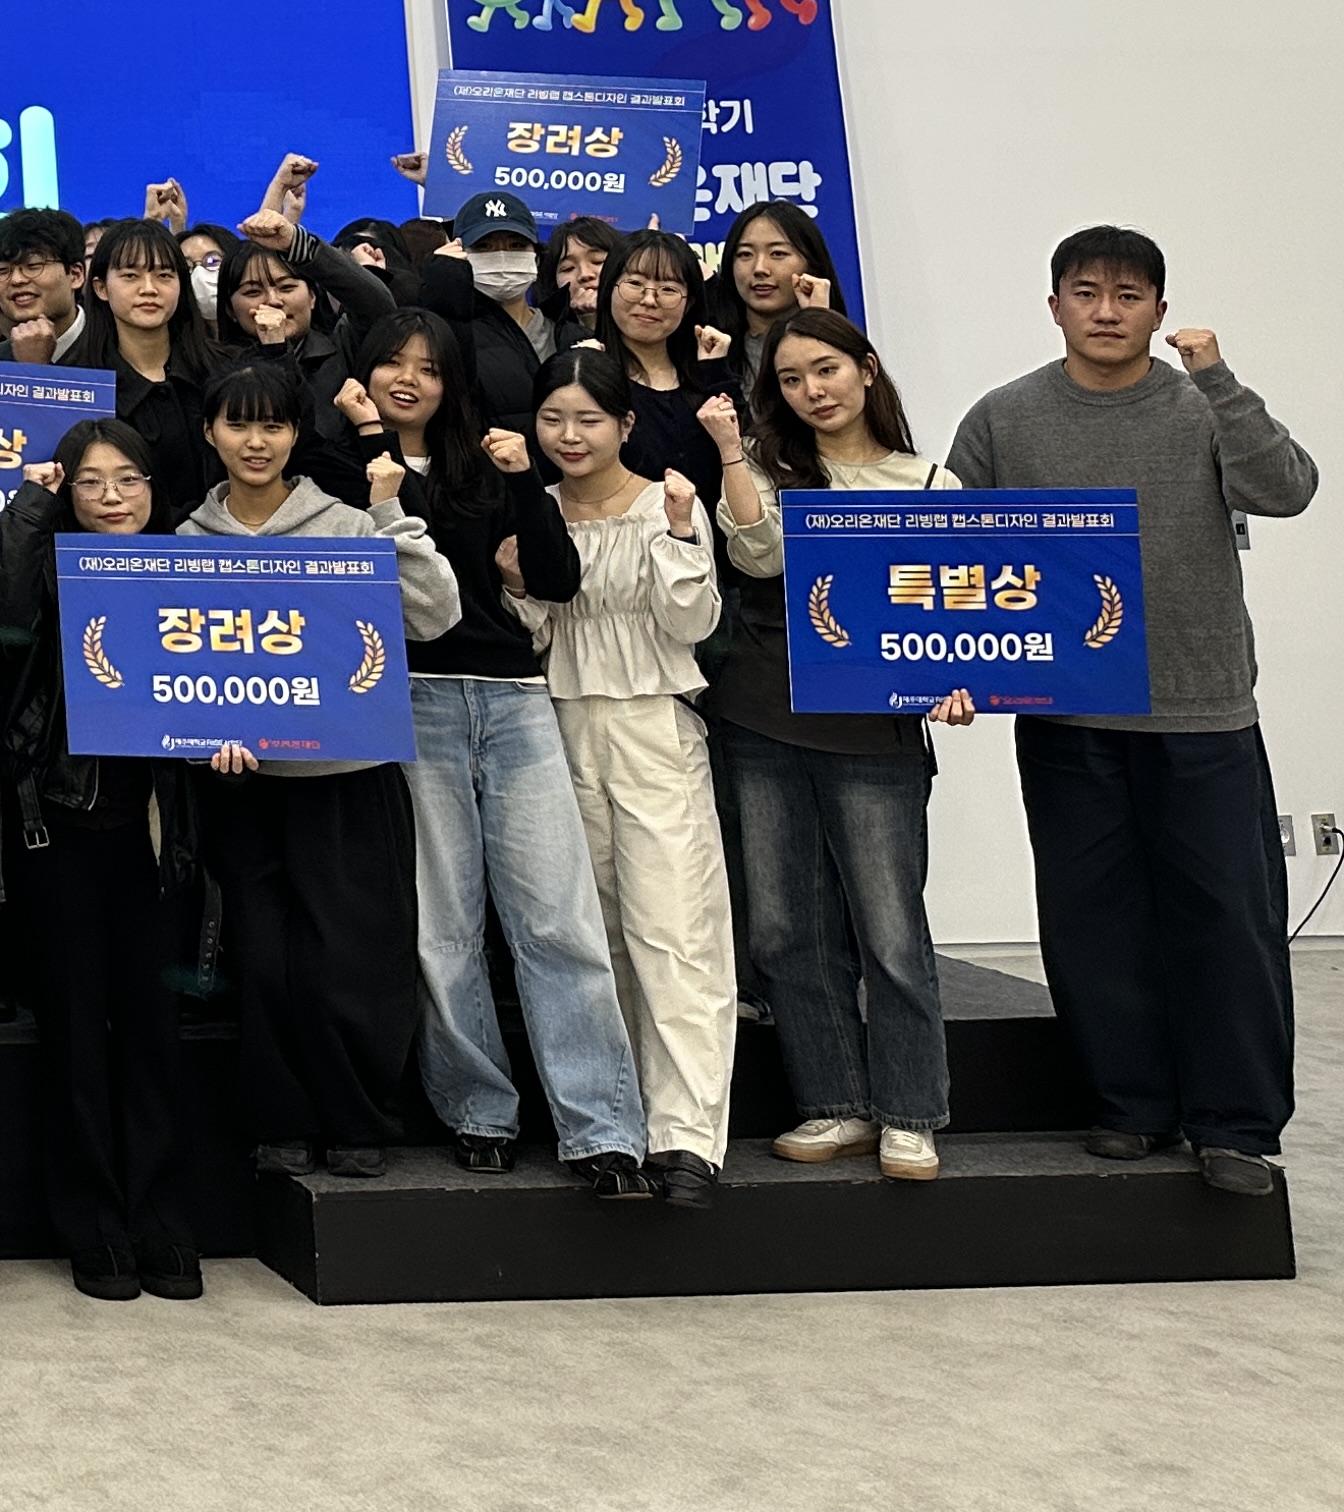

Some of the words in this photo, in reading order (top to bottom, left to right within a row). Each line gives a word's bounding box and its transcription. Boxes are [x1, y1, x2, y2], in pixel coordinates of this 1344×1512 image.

[506, 121, 624, 159] 장려상
[494, 165, 625, 194] 500,000원
[887, 564, 1042, 612] 특별상
[158, 607, 306, 656] 장려상
[880, 632, 1054, 663] 500,000원
[152, 675, 321, 707] 500,000원
